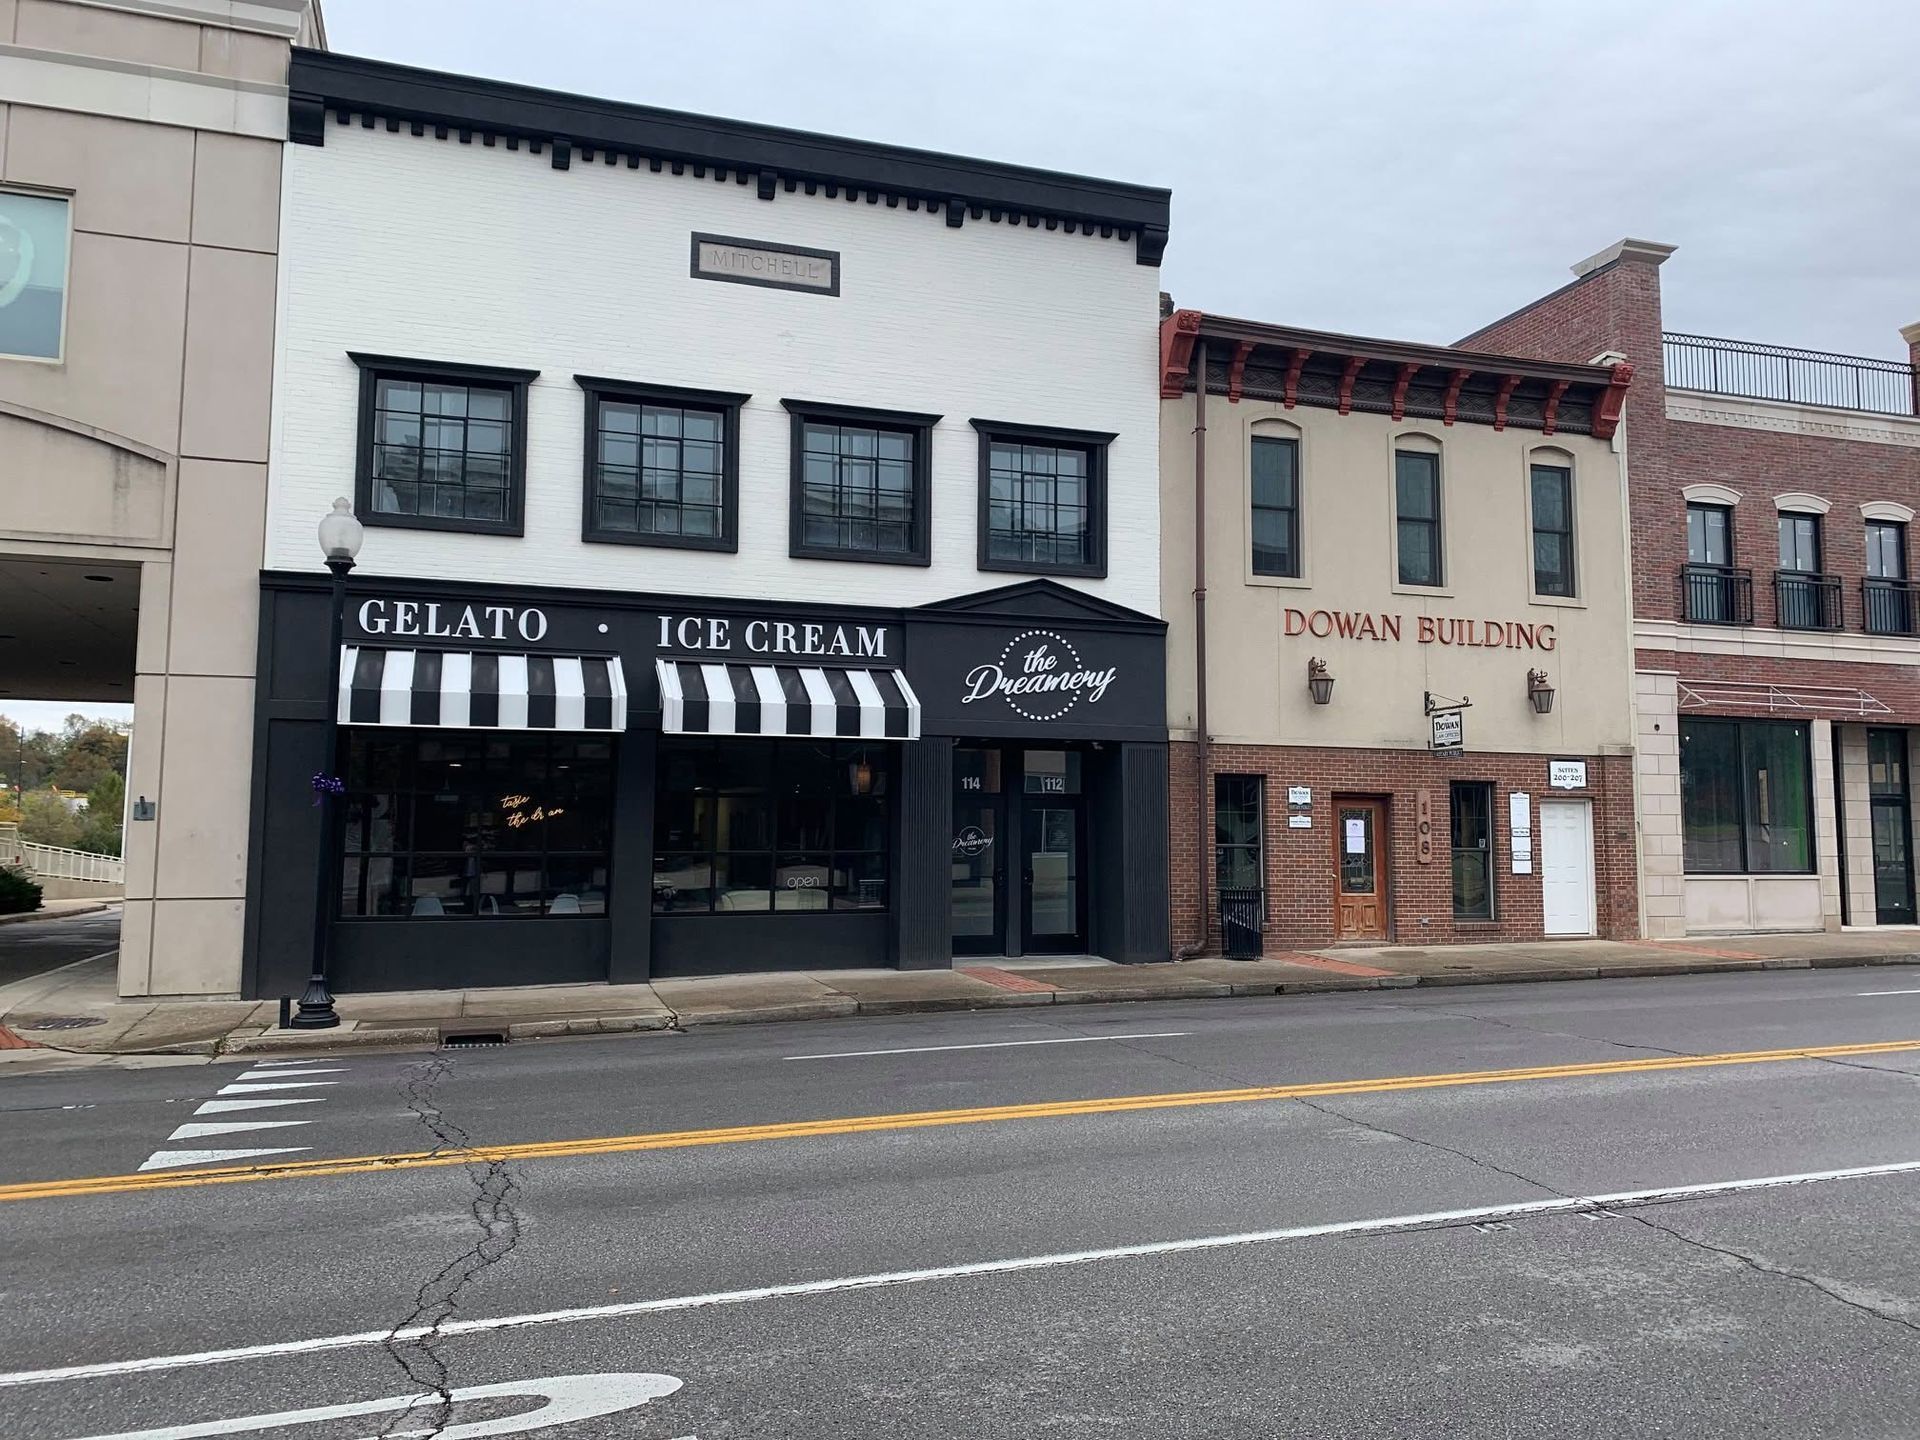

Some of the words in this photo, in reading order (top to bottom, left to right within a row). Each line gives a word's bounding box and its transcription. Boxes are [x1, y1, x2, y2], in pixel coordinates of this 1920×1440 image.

[712, 250, 818, 279] MITCHELL
[358, 599, 548, 642] GELATO
[656, 615, 731, 650] ICE
[744, 620, 888, 658] CREAM
[1284, 608, 1401, 642] DOWAN
[1417, 616, 1557, 651] BUILDING
[1023, 644, 1058, 674] the
[961, 664, 1117, 704] Dreamery
[1435, 720, 1460, 731] DOWAN
[961, 776, 981, 790] 114
[1045, 777, 1063, 790] 112
[1553, 774, 1583, 783] 200-207
[507, 811, 529, 828] the
[787, 876, 820, 889] open
